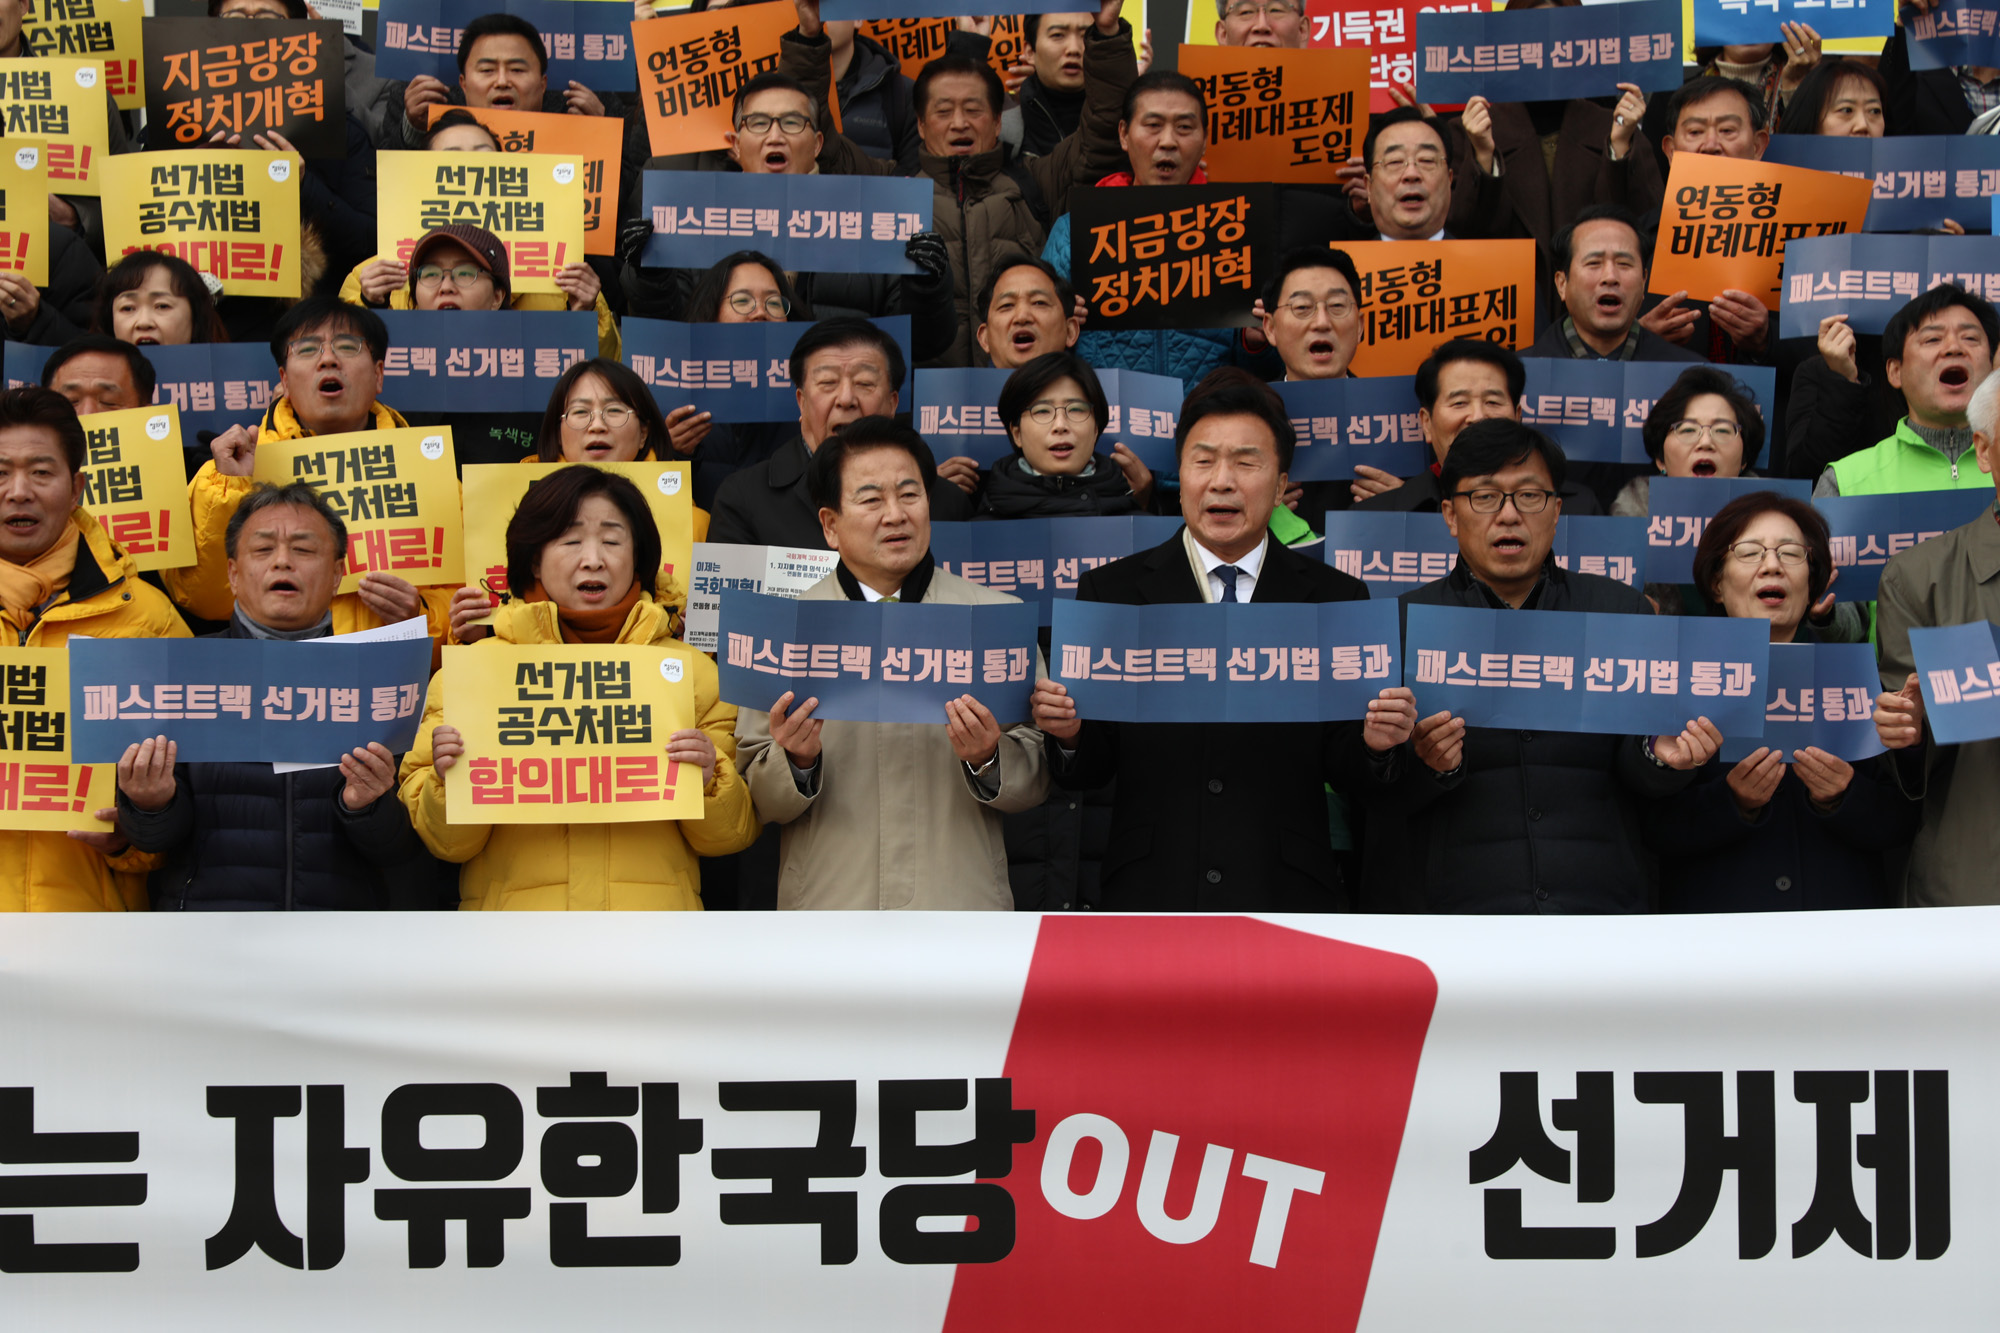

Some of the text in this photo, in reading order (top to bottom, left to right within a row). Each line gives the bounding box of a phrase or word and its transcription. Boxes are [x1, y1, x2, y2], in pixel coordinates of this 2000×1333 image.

[1312, 8, 1406, 47] 기득권
[1912, 8, 1998, 41] 패스트트랙
[162, 31, 323, 92] 지금당장
[583, 34, 627, 60] 통과
[647, 25, 743, 84] 연동형
[1425, 32, 1675, 73] 패스트트랙 선거법 통과
[166, 79, 324, 143] 정치개혁
[1290, 128, 1353, 166] 도입
[151, 164, 244, 197] 선거법
[435, 166, 528, 197] 선거법
[1873, 171, 1946, 198] 선거법
[139, 200, 261, 235] 공수처법
[1675, 183, 1782, 220] 연동형
[652, 205, 923, 241] 패스트트랙 선거법 통과
[1089, 195, 1251, 264] 지금당장
[1091, 245, 1251, 317] 정치개혁
[1789, 270, 1919, 303] 패스트트랙
[446, 348, 525, 377] 선거법
[631, 354, 758, 389] 패스트트랙
[223, 380, 273, 410] 통과
[920, 405, 1007, 435] 패스트트
[1128, 406, 1177, 439] 통과
[1346, 413, 1424, 444] 선거법
[293, 444, 397, 488] 선거법
[1647, 514, 1712, 548] 선거
[342, 526, 444, 577] 대로!
[696, 561, 721, 573] 이제는
[727, 631, 1030, 684] 패스트트랙 선거법 통과
[1060, 643, 1392, 682] 패스트트랙 선거법 통과
[1415, 648, 1756, 697] 패스트트랙 선거법 통과
[515, 661, 631, 701] 선거법
[83, 682, 420, 722] 패스트트랙 선거법 통과
[1822, 687, 1873, 722] 통과
[498, 704, 652, 746] 공수처법
[468, 755, 680, 805] 합의대로!
[0, 1071, 1037, 1273] 는 자유한국당
[1468, 1069, 1952, 1262] 선거제
[1039, 1111, 1327, 1270] OUT
